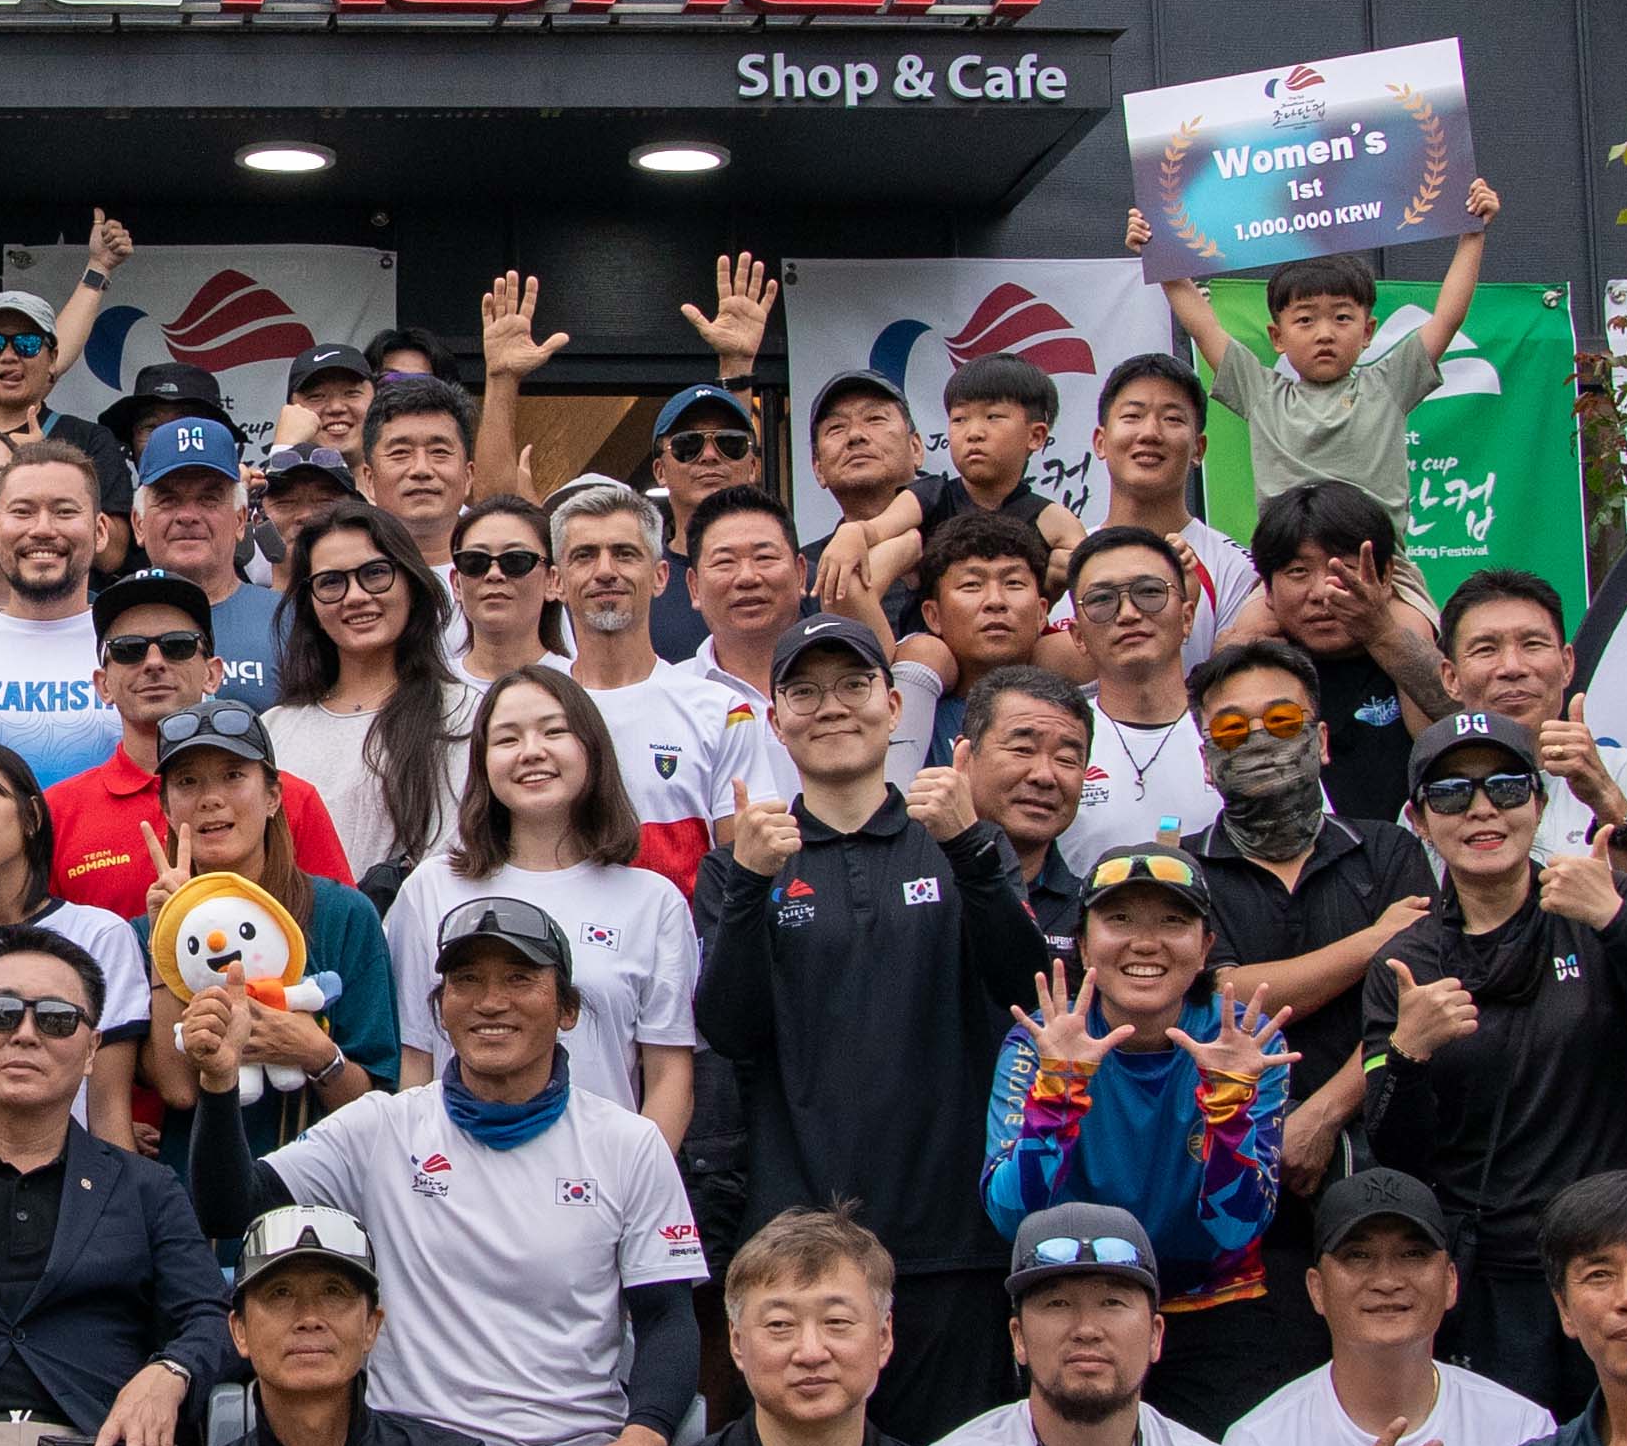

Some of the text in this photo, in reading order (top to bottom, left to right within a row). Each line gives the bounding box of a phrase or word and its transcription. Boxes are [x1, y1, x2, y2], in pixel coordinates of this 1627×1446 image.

[737, 52, 1068, 107] Shop & Cafe
[1212, 123, 1387, 179] Women's
[1287, 178, 1323, 201] 1st
[1234, 201, 1382, 241] 1,000,000 KRW
[1421, 456, 1458, 476] cup
[1439, 544, 1488, 557] Festival
[67, 854, 131, 880] ROMANIA
[83, 849, 112, 862] TEAM
